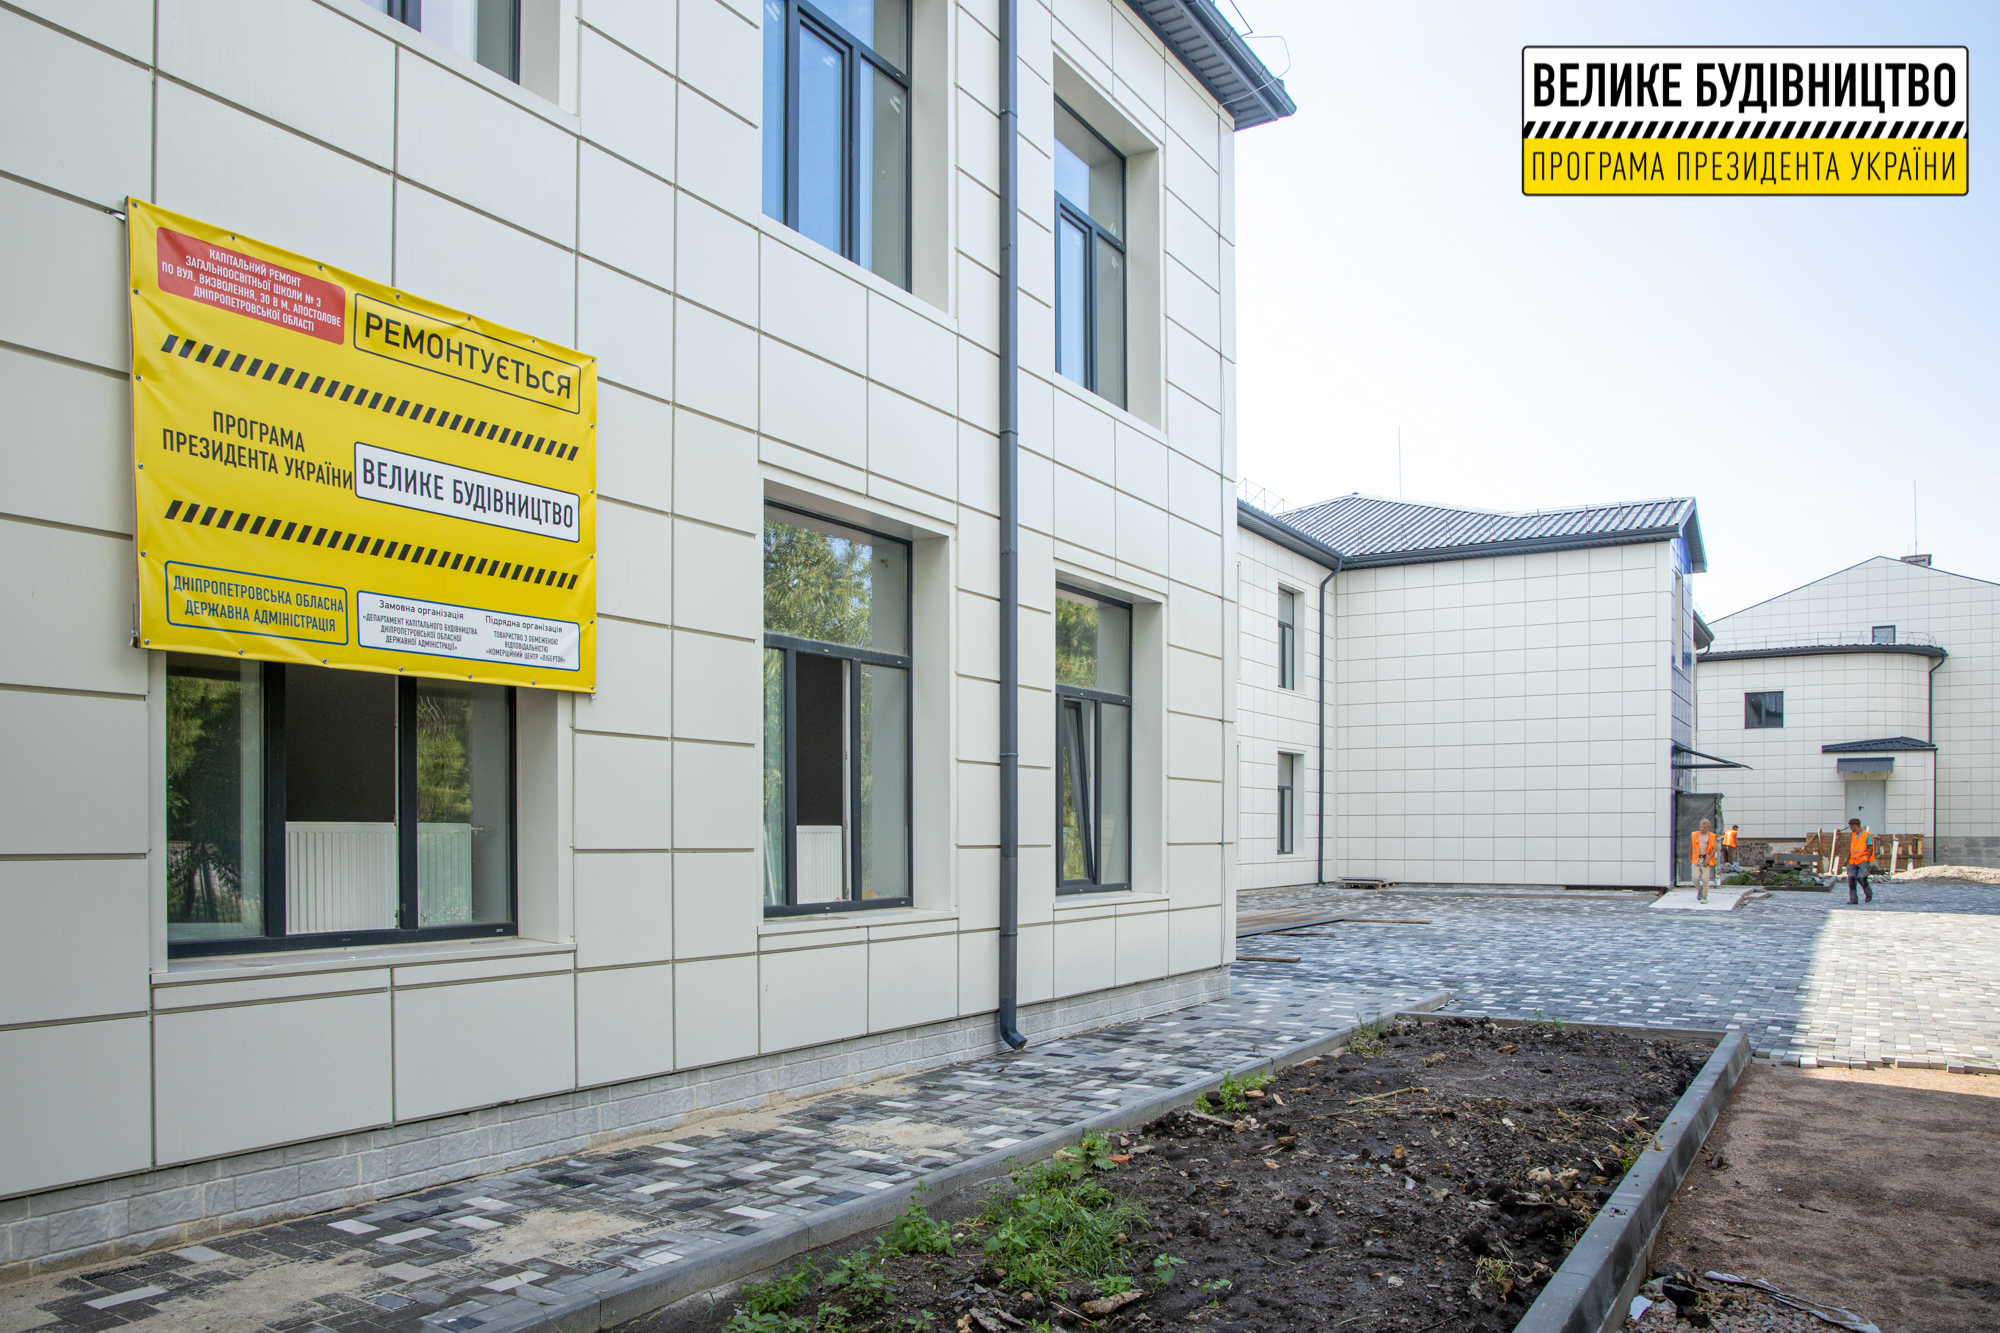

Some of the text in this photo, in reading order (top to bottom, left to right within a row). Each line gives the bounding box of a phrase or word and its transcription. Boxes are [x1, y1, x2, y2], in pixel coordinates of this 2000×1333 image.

[185, 256, 271, 291] ЗАГАЛЬНООСВІТНЬОЇ
[273, 284, 302, 301] ШКОЛИ
[316, 298, 321, 307] 3
[209, 249, 301, 288] КАПІТАЛЬНИЙ РЕМОНТ
[162, 262, 341, 327] ПО ВУЛ. ВИЗВОЛЕННЯ, 30 В М. АПОСТОЛОВЕ
[193, 286, 314, 332] ДНІПРОПЕТРОВСЬКОЇ ОБЛАСТІ
[365, 312, 571, 399] РЕМОНТУЄТЬСЯ
[213, 411, 305, 452] ПРОГРАМА
[163, 428, 352, 490] ПРЕЗИДЕНТА УКРАЇНИ
[363, 458, 573, 528] ВЕЛИКЕ БУДІВНИЦТВО
[174, 575, 344, 612] ДНІПРОПЕТРОВСЬКА ОБЛАСНА
[379, 600, 464, 620] Замовна організація
[185, 600, 335, 633] ДЕРЖАВНА АДМІНІСТРАЦІЯ
[381, 625, 462, 642] ДНІПРОПЕТРОВСЬКОЇ ОБЛАСНОЇ
[406, 618, 442, 630] КАПІТАЛЬНОГО
[444, 623, 477, 635] БУДІВНИЦТВА
[485, 616, 562, 634] Підрядна організація
[386, 635, 416, 646] ДЕРЖАВНОЇ
[494, 630, 523, 641] ТОВАРИСТВО
[528, 635, 558, 646] ОБМЕЖЕНОЮ
[504, 641, 548, 653] ВІДПОВІДАЛЬНІСТЮ
[524, 651, 538, 660] ЦЕНТР
